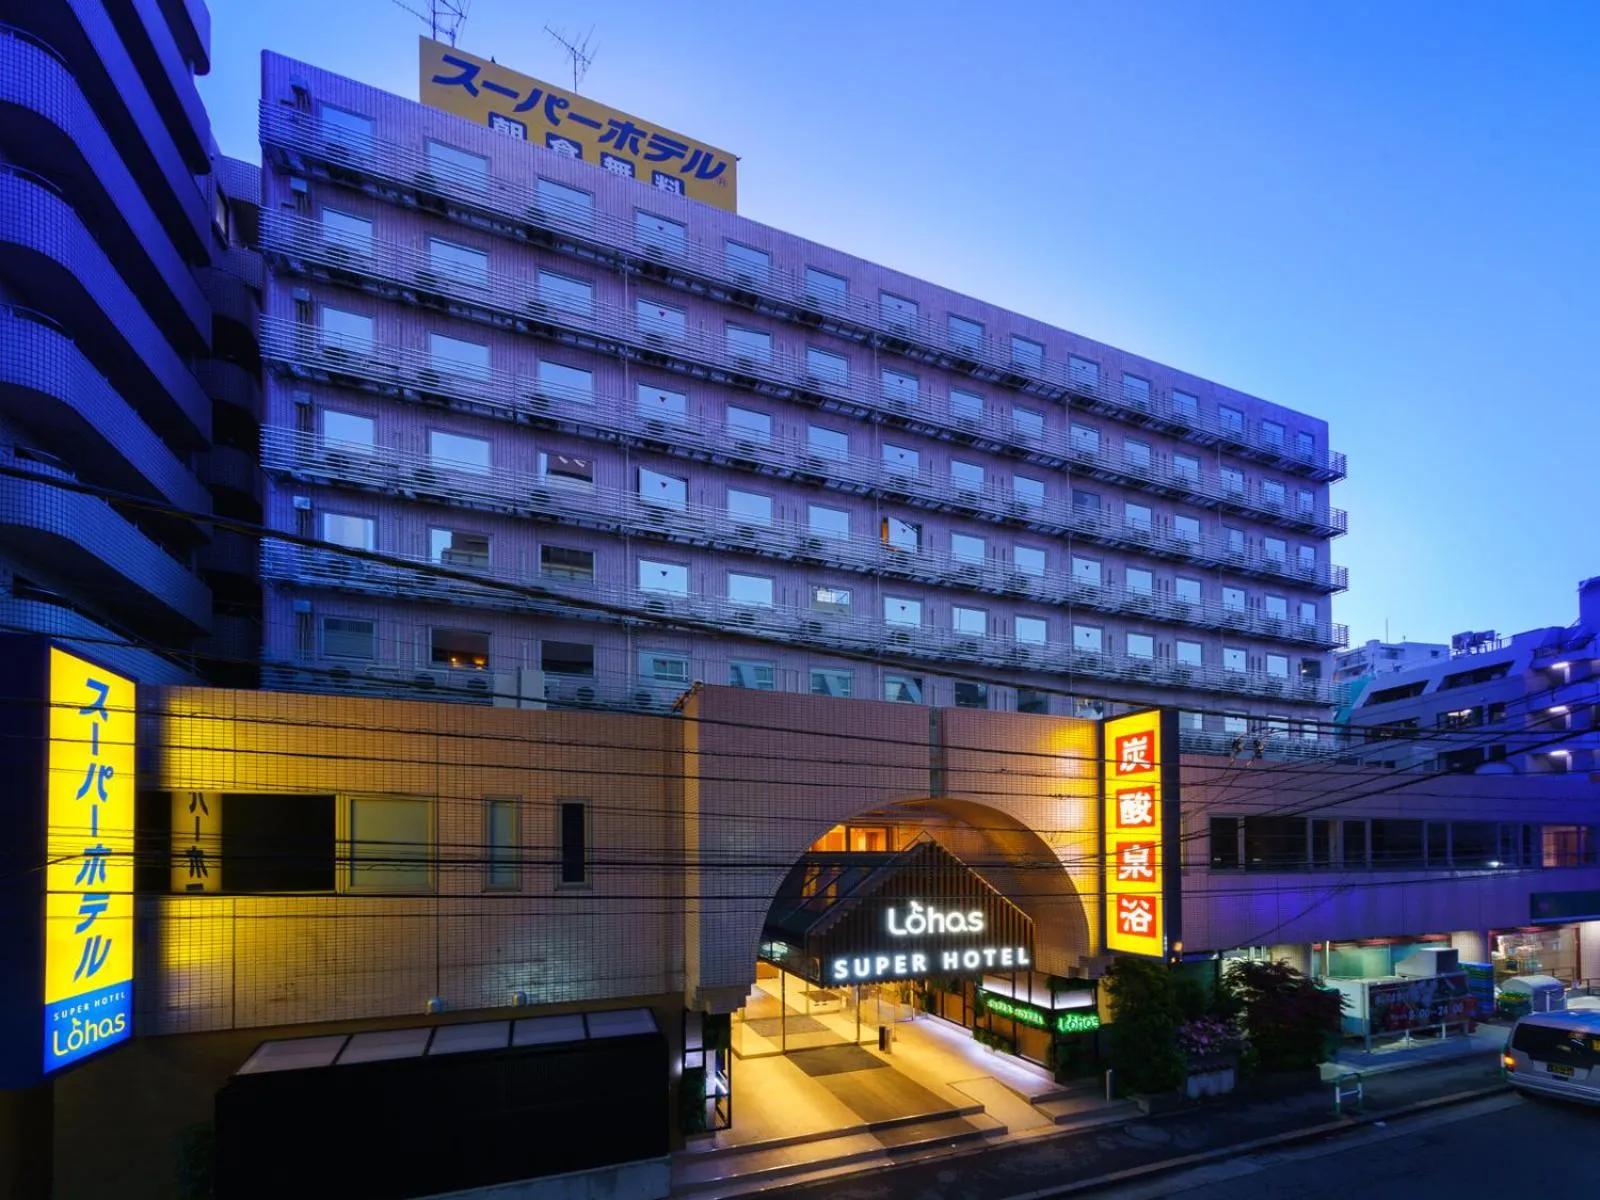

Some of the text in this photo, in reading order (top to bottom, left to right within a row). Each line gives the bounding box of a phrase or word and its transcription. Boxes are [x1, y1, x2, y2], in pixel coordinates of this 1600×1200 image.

[432, 54, 727, 180] スーパーホテル
[73, 677, 114, 983] スーパーホテル
[1119, 735, 1153, 934] 炭酸泉浴
[53, 991, 125, 1021] SUPER HOTEL
[834, 947, 1031, 980] SUPER HOTEL
